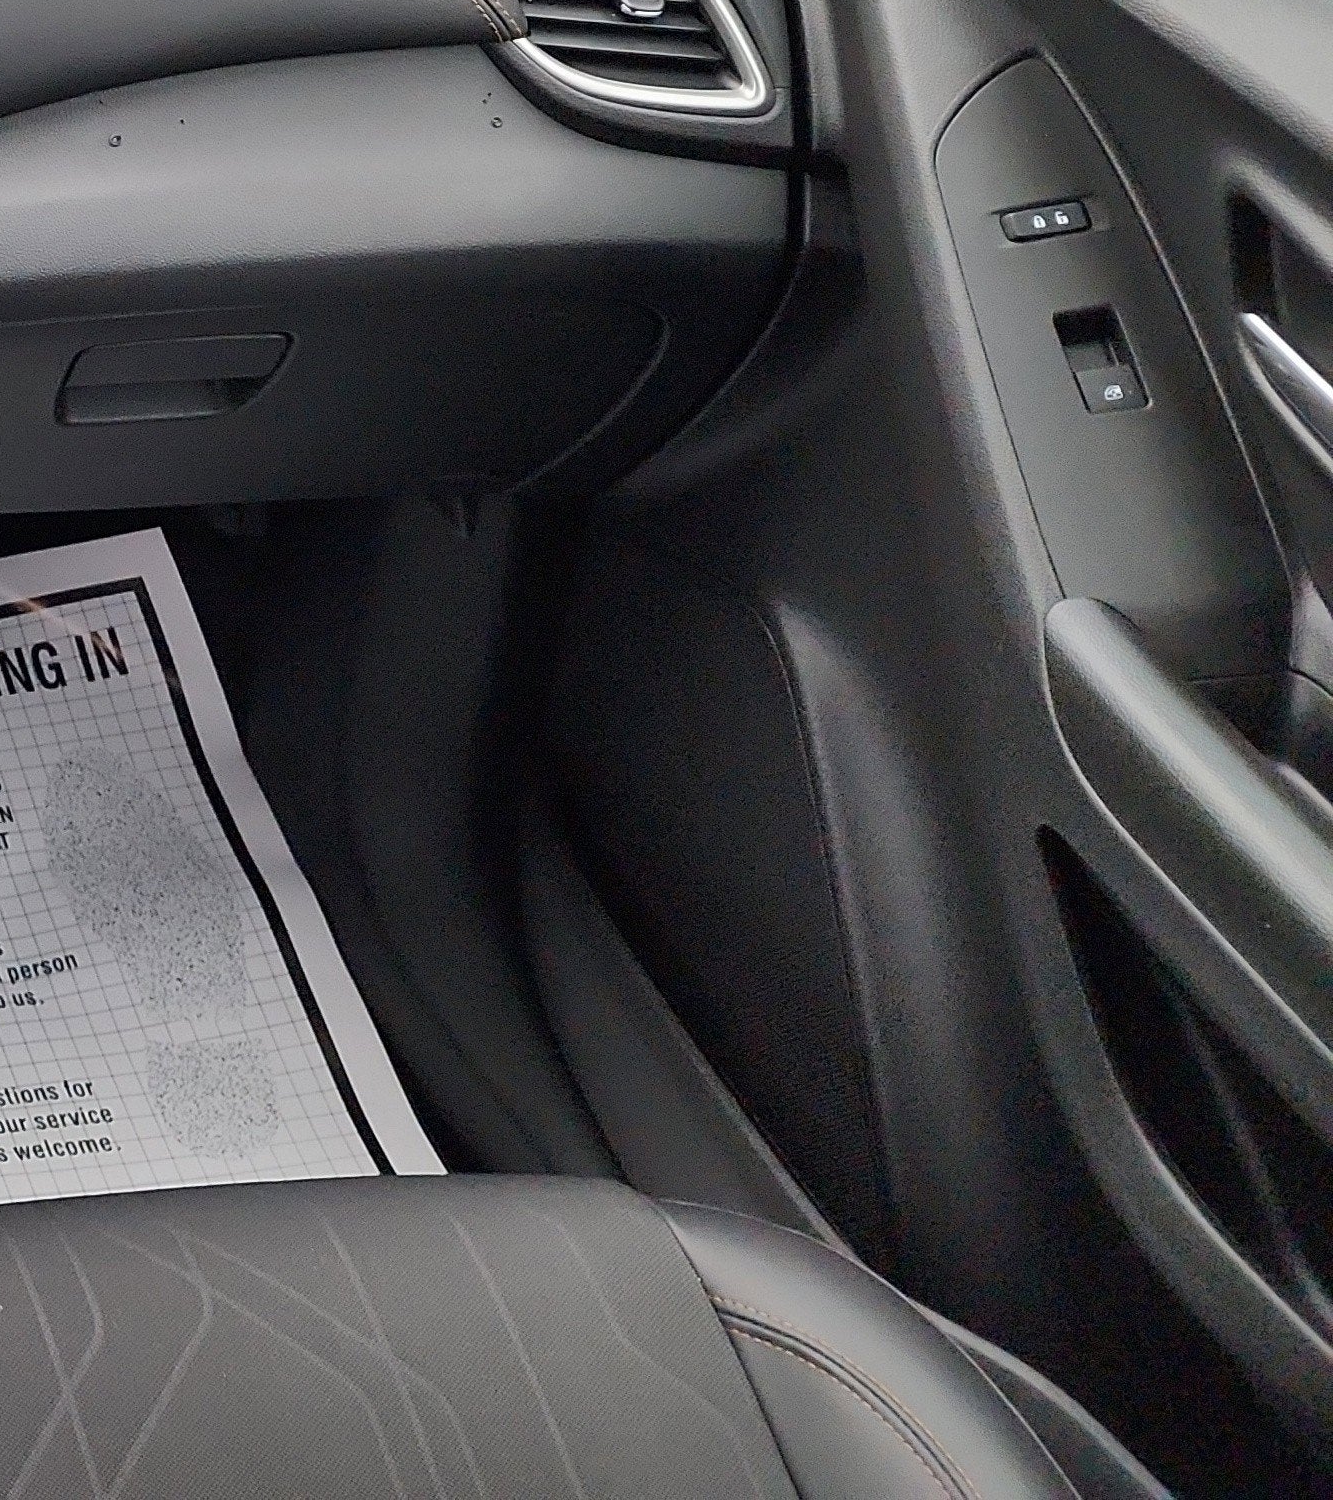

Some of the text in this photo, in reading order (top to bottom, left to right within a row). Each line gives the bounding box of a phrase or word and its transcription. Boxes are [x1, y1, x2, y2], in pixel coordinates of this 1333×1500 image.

[74, 626, 129, 682] IN
[7, 952, 79, 983] person
[63, 1079, 94, 1098] for
[33, 1106, 114, 1131] service
